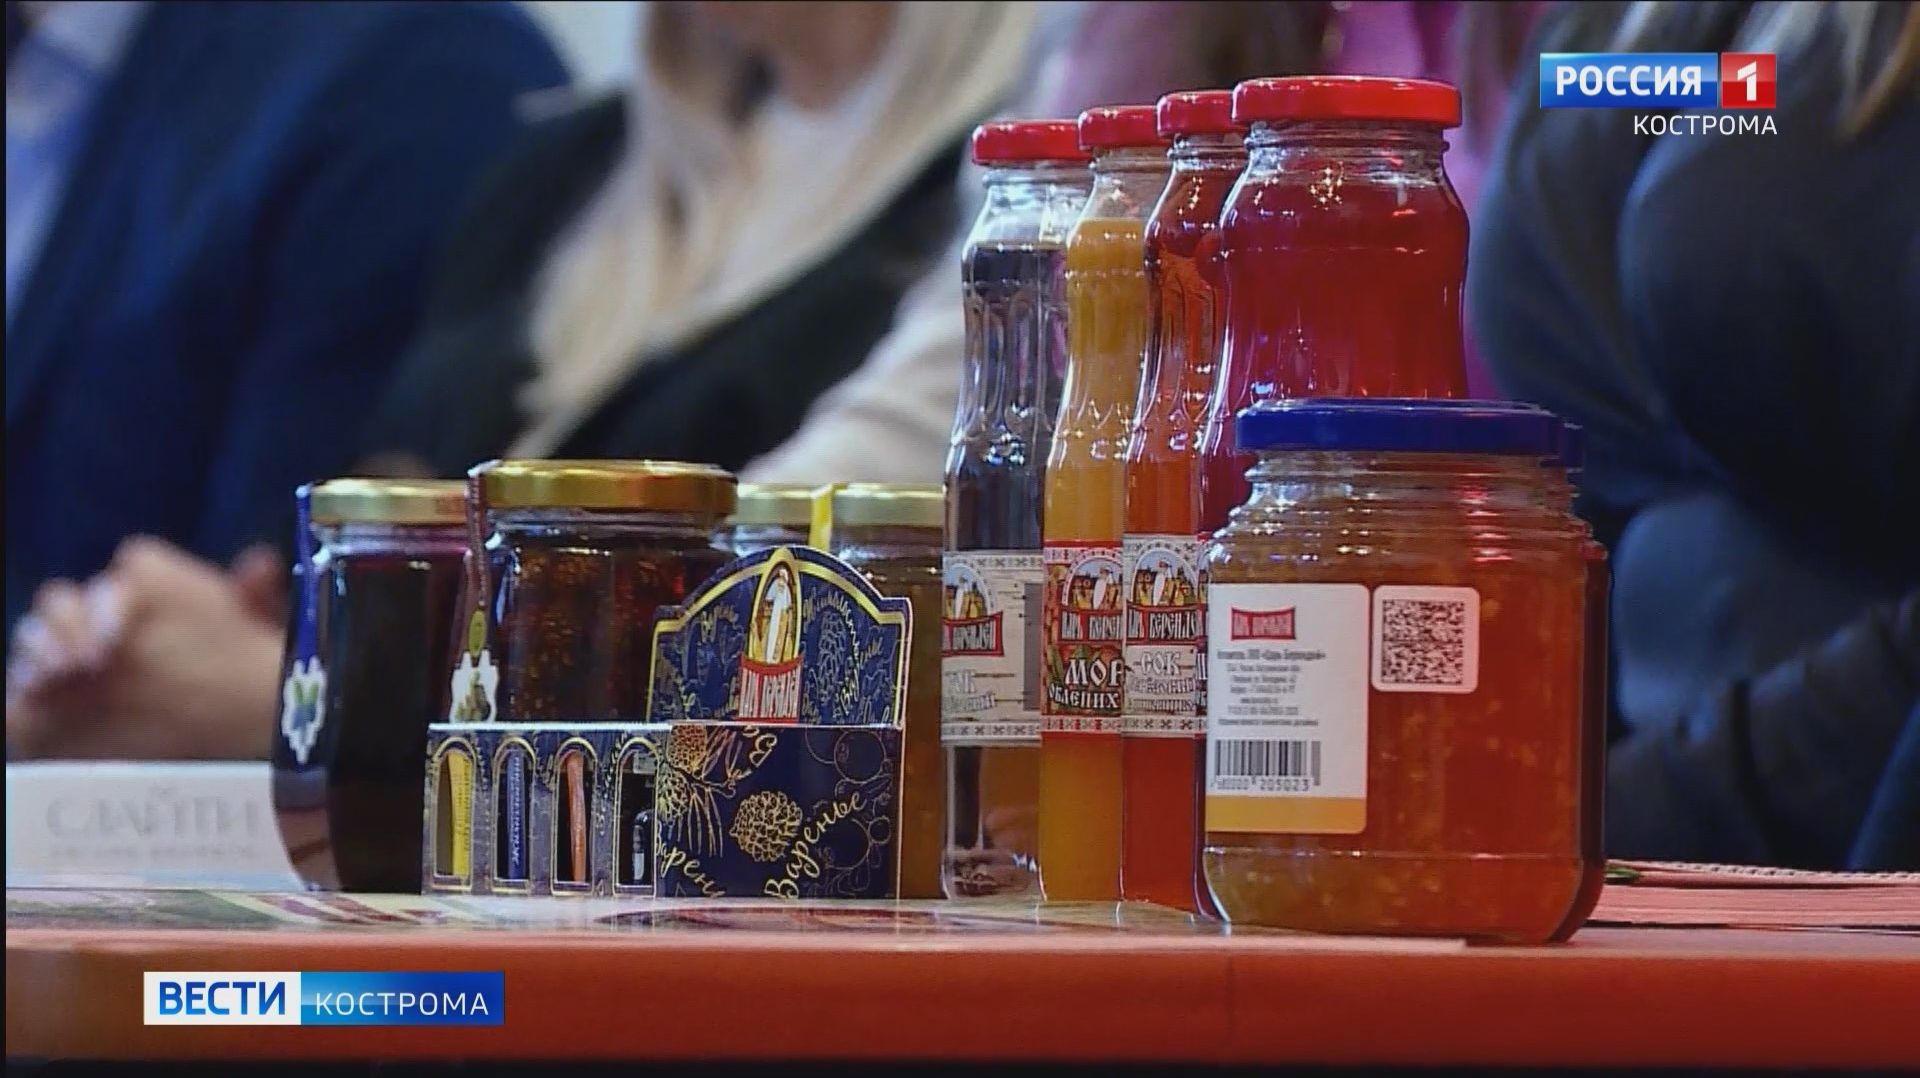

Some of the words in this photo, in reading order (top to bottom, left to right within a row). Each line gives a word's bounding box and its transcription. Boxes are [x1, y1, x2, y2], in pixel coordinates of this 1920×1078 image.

[1064, 658, 1122, 687] МОР
[1141, 652, 1181, 676] СОК
[1049, 684, 1119, 709] ОБЛЕПИХ
[763, 792, 867, 900] Варенье
